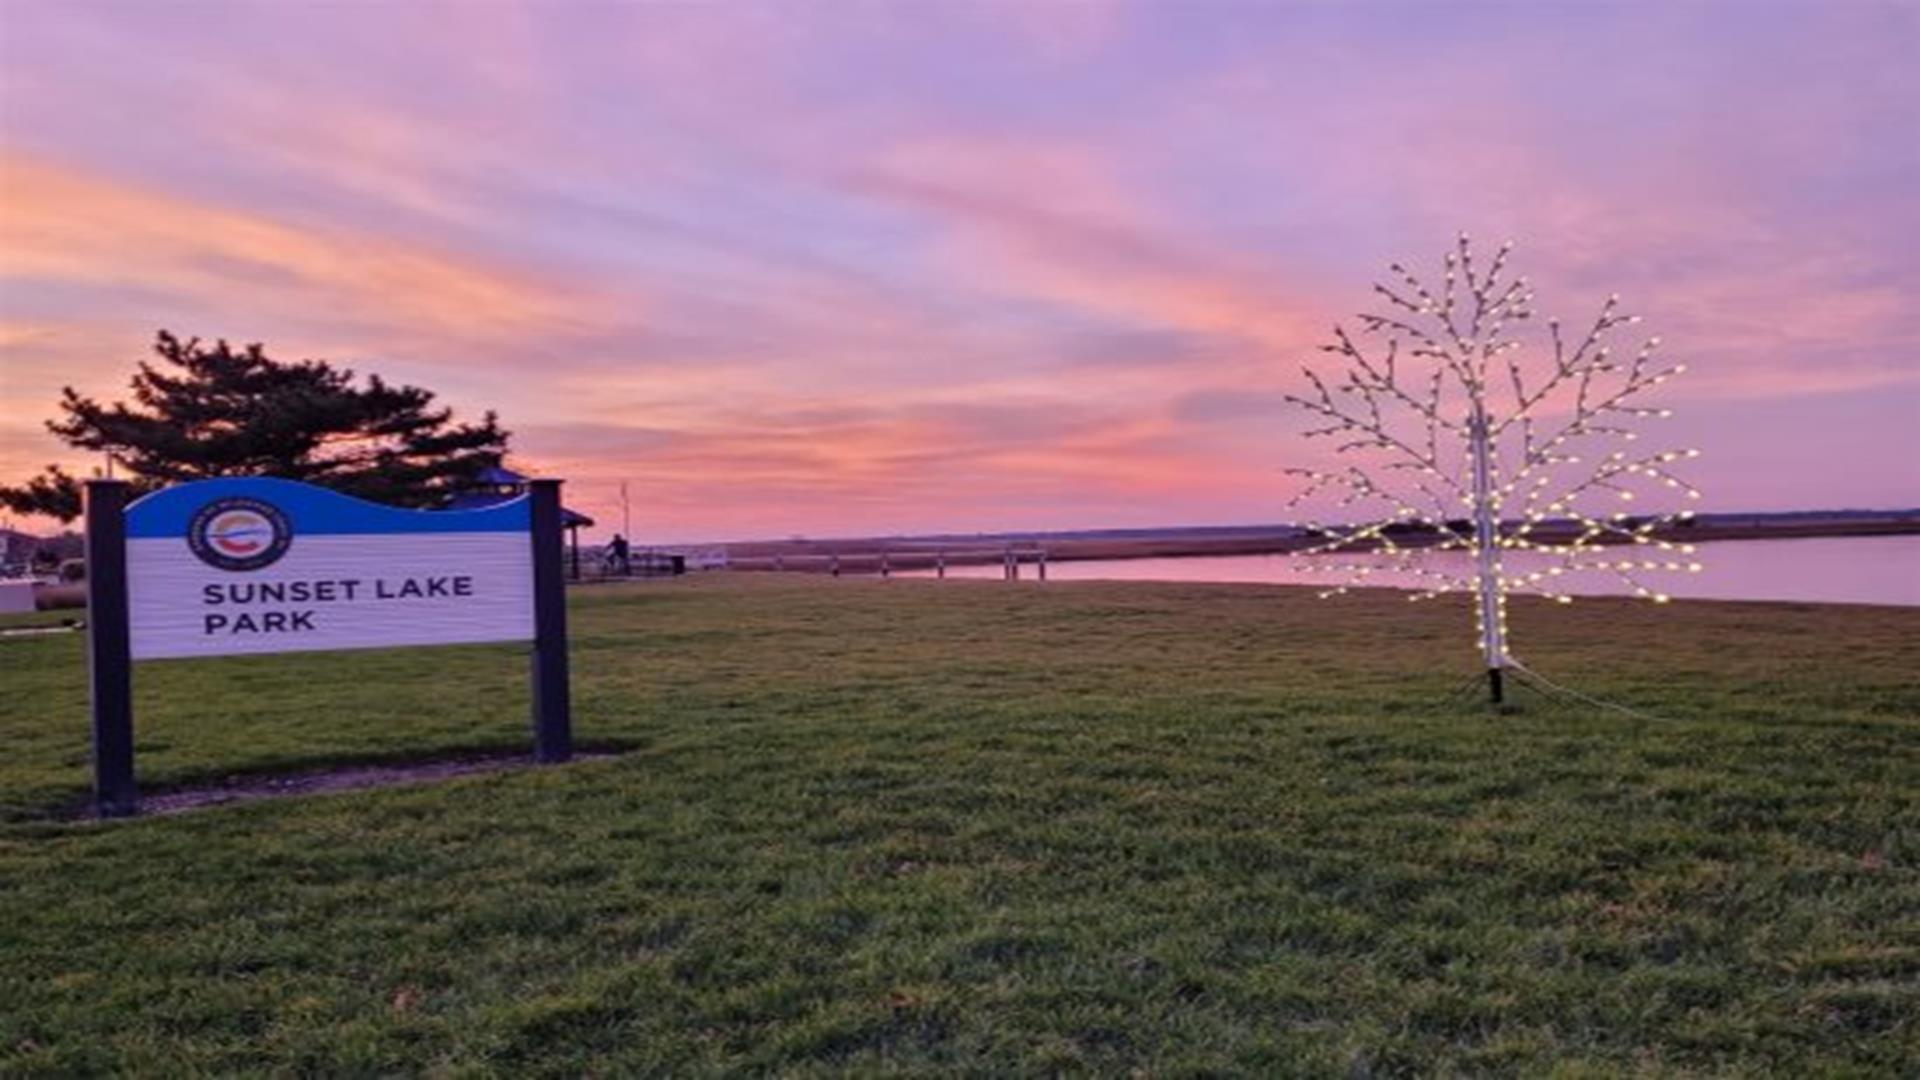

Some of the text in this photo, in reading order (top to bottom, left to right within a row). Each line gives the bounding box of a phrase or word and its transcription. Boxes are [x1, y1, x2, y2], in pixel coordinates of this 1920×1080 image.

[203, 576, 473, 605] SUNSET LAKE
[204, 610, 316, 635] PARK
